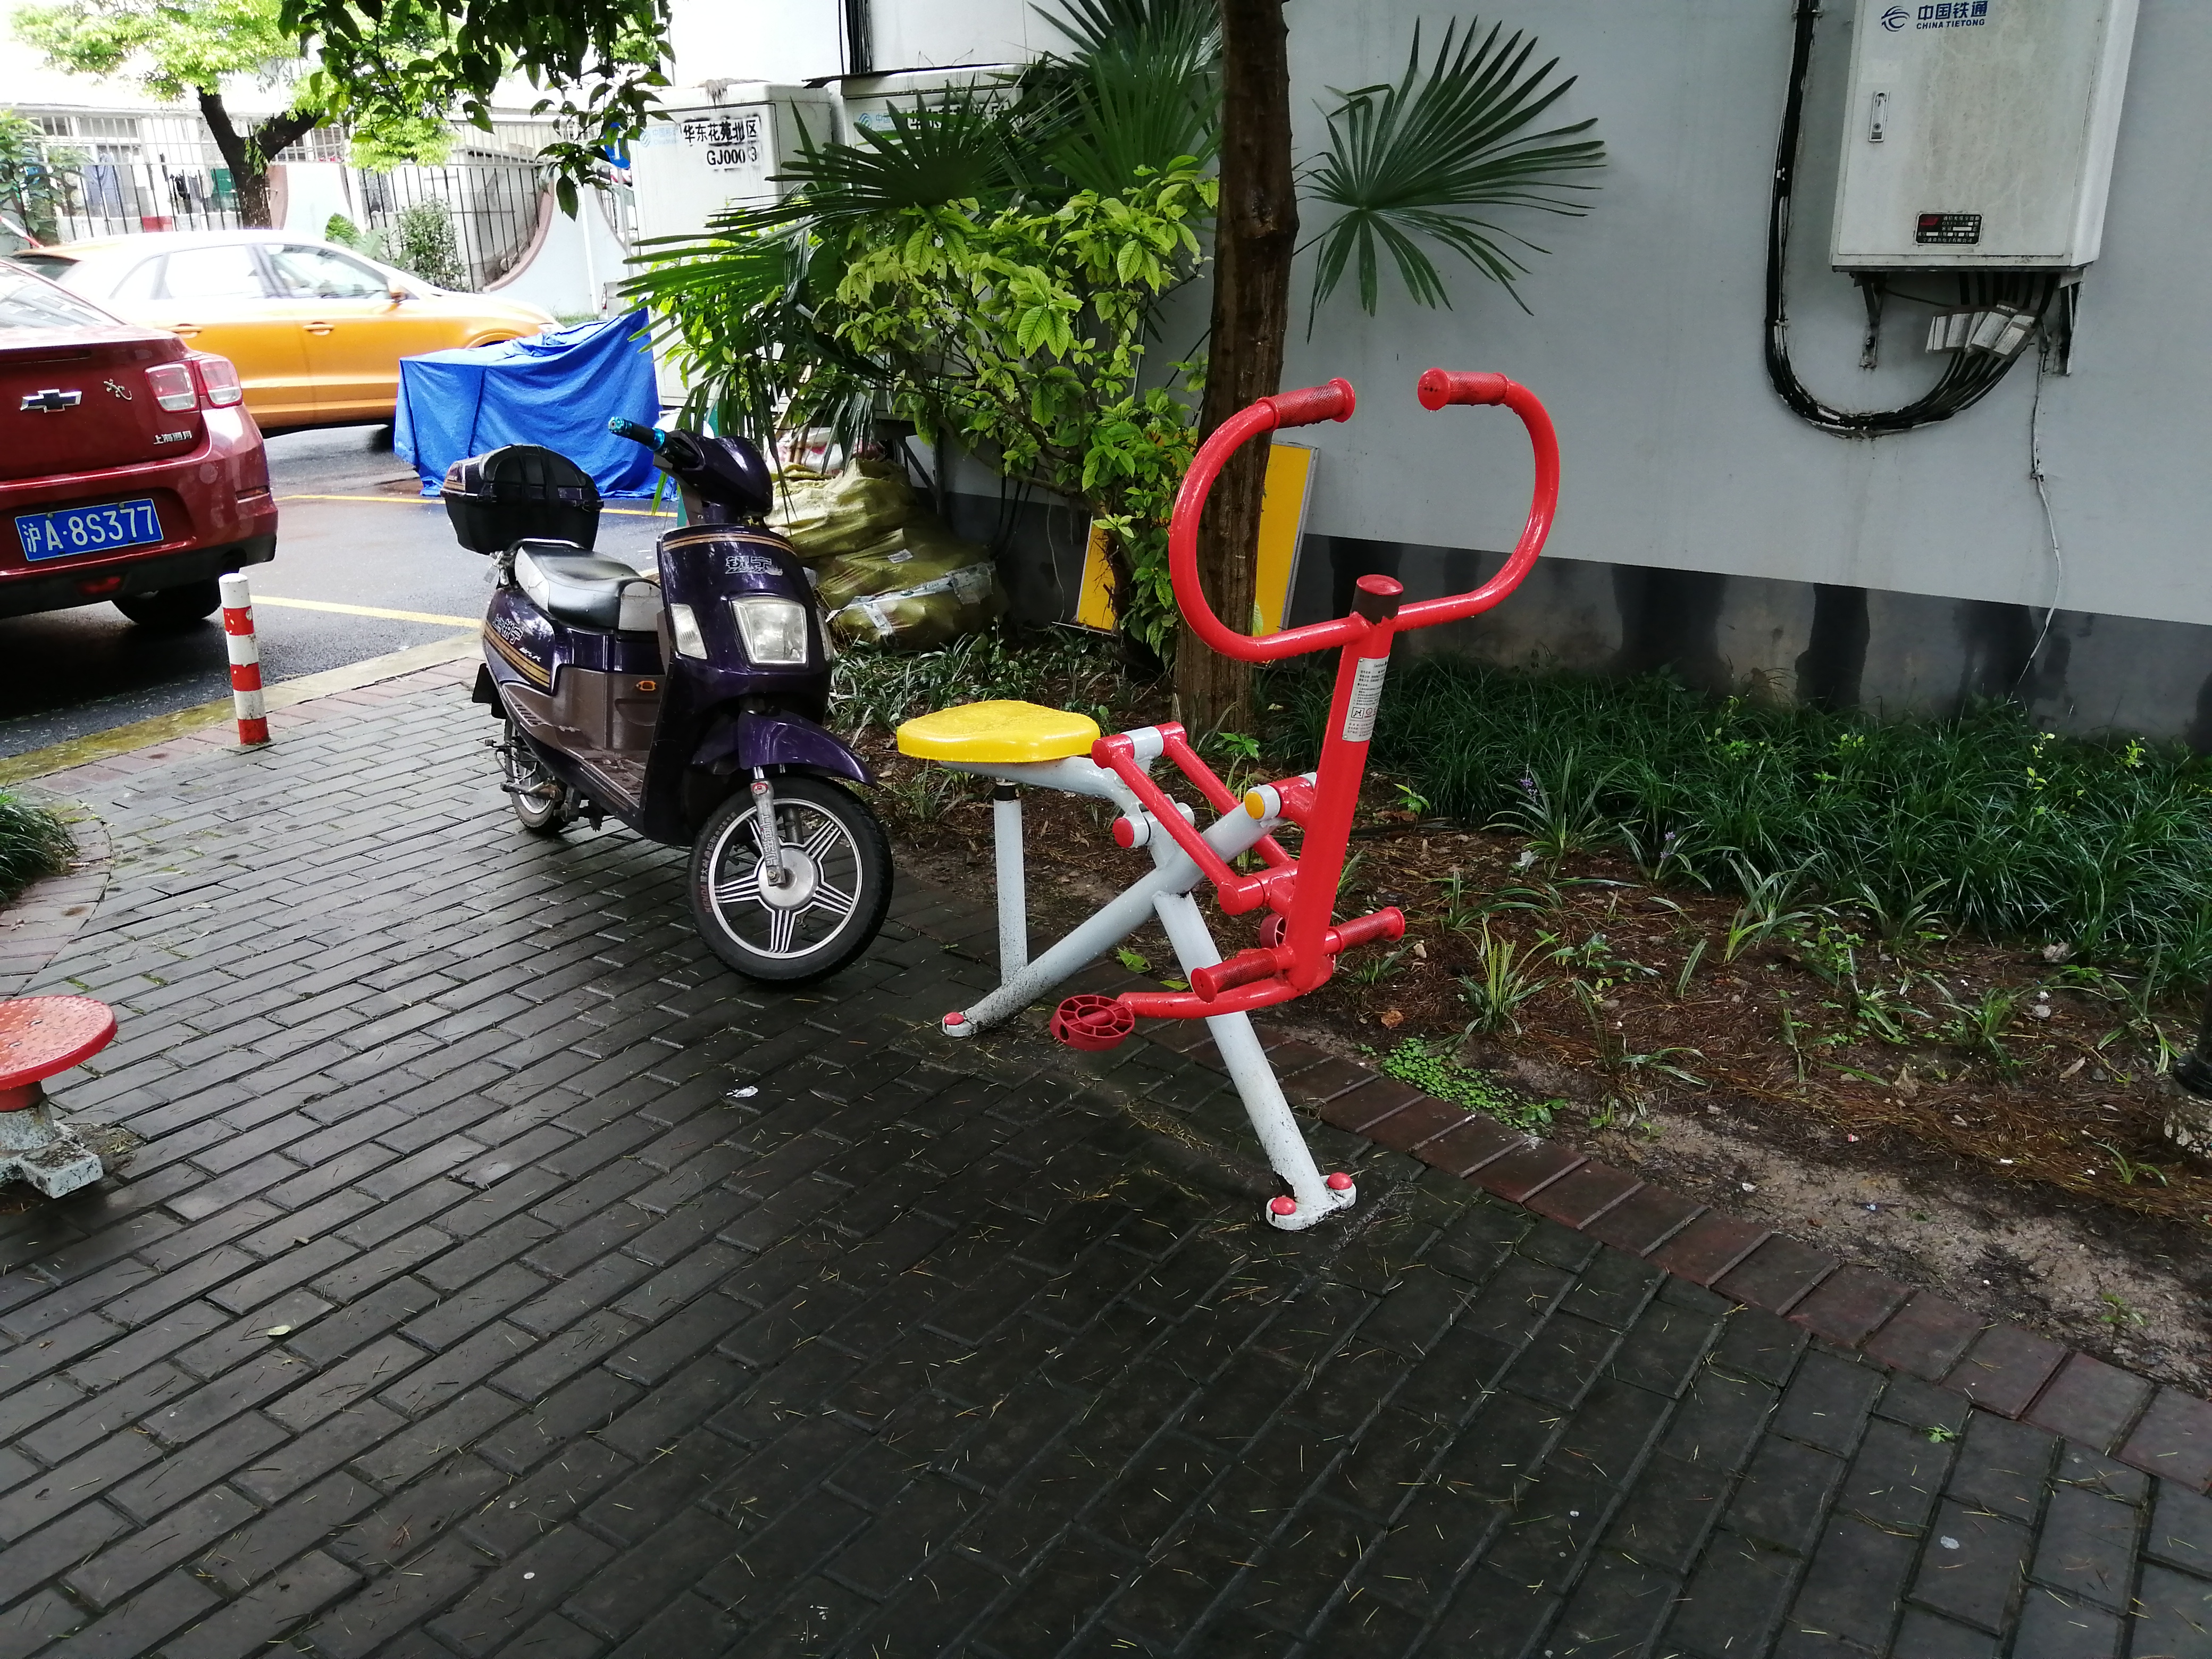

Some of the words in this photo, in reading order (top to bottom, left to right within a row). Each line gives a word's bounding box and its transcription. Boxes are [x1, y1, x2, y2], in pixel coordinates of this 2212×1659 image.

[1917, 1, 1988, 20] 中国铁通
[1916, 21, 1943, 30] CHINA
[1946, 19, 1985, 27] TIETONG
[683, 120, 757, 143] 华东花苑北区
[153, 430, 192, 445] 上海通用
